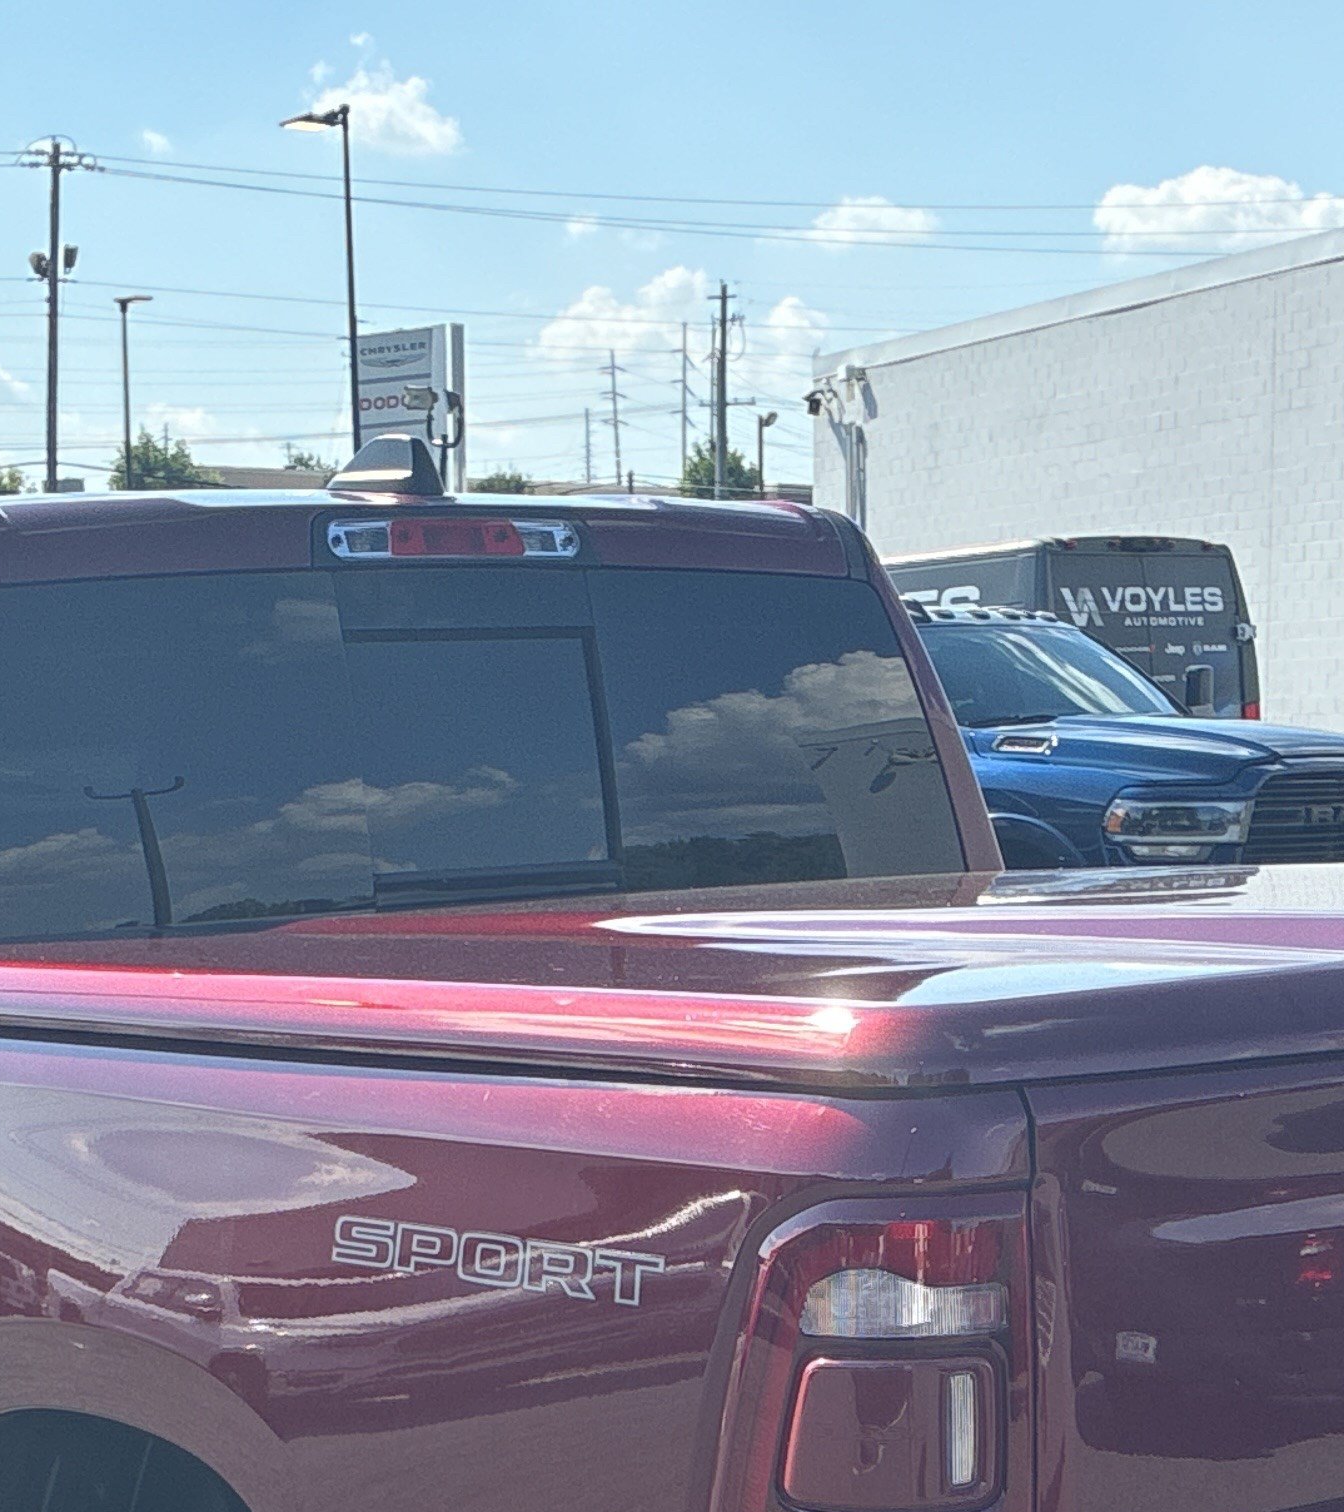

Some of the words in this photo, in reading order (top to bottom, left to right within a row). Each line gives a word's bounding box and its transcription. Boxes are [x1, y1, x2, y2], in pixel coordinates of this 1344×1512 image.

[359, 341, 426, 356] CHRYSLER
[359, 394, 409, 411] DOD
[1101, 586, 1224, 613] VOYLES
[1124, 616, 1205, 627] AUTOMOTIVE
[331, 1214, 666, 1307] SPORT
